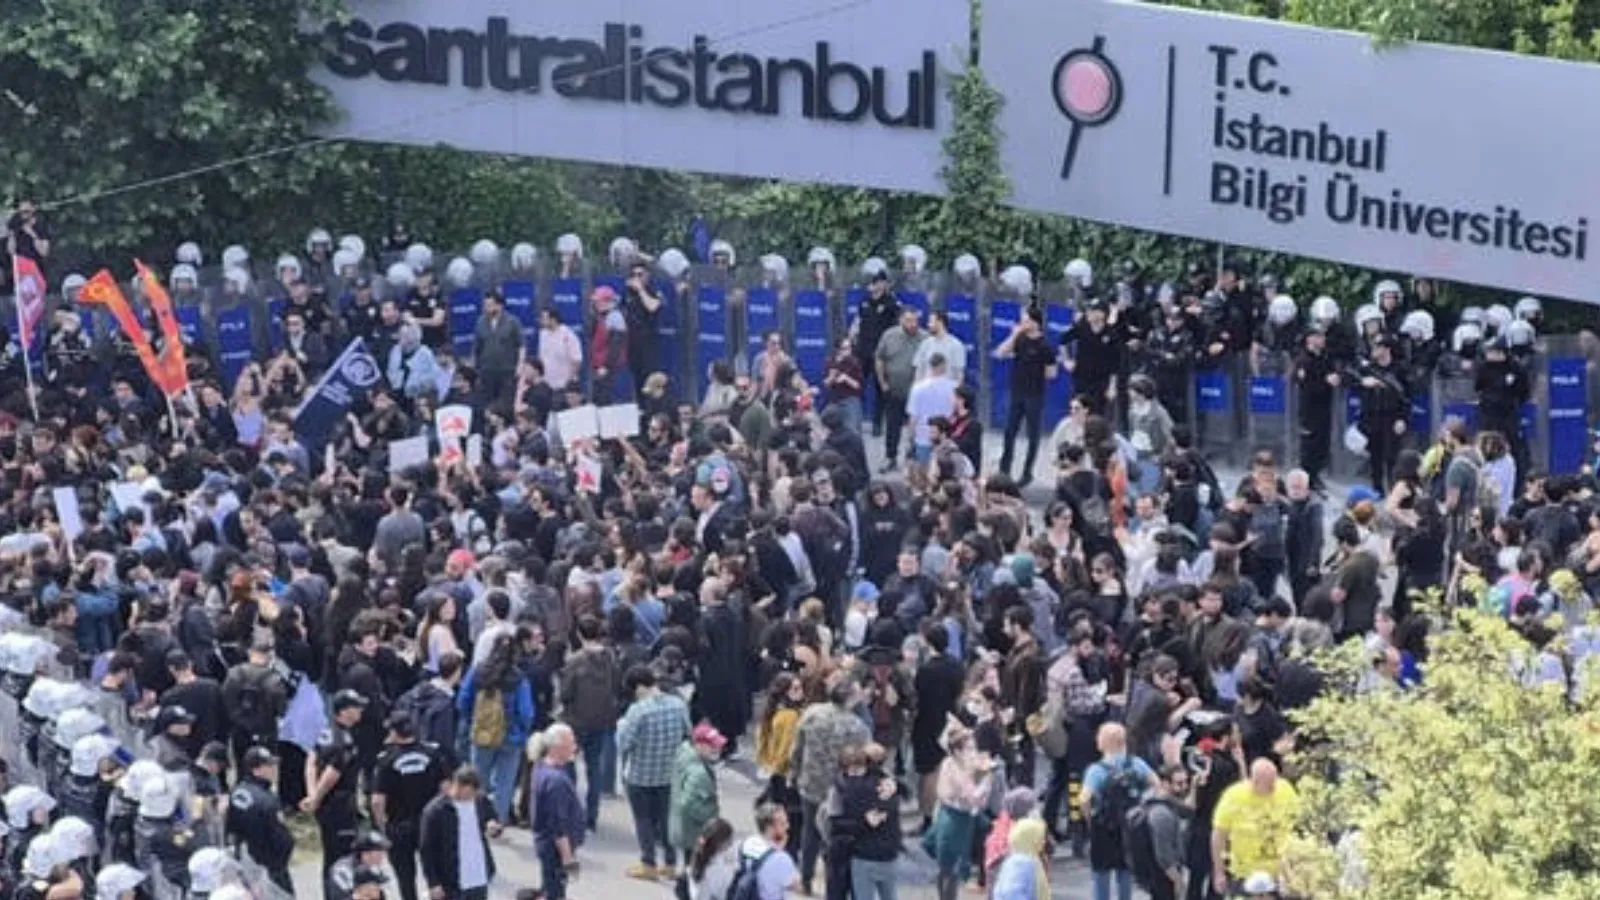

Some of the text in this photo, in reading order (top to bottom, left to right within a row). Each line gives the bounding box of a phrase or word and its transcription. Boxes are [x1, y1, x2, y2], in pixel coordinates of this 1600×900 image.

[324, 17, 937, 130] santralistanbul
[1208, 45, 1291, 96] T.C.
[1213, 92, 1388, 173] İstanbul
[1210, 162, 1588, 261] Bilgi Üniversitesi
